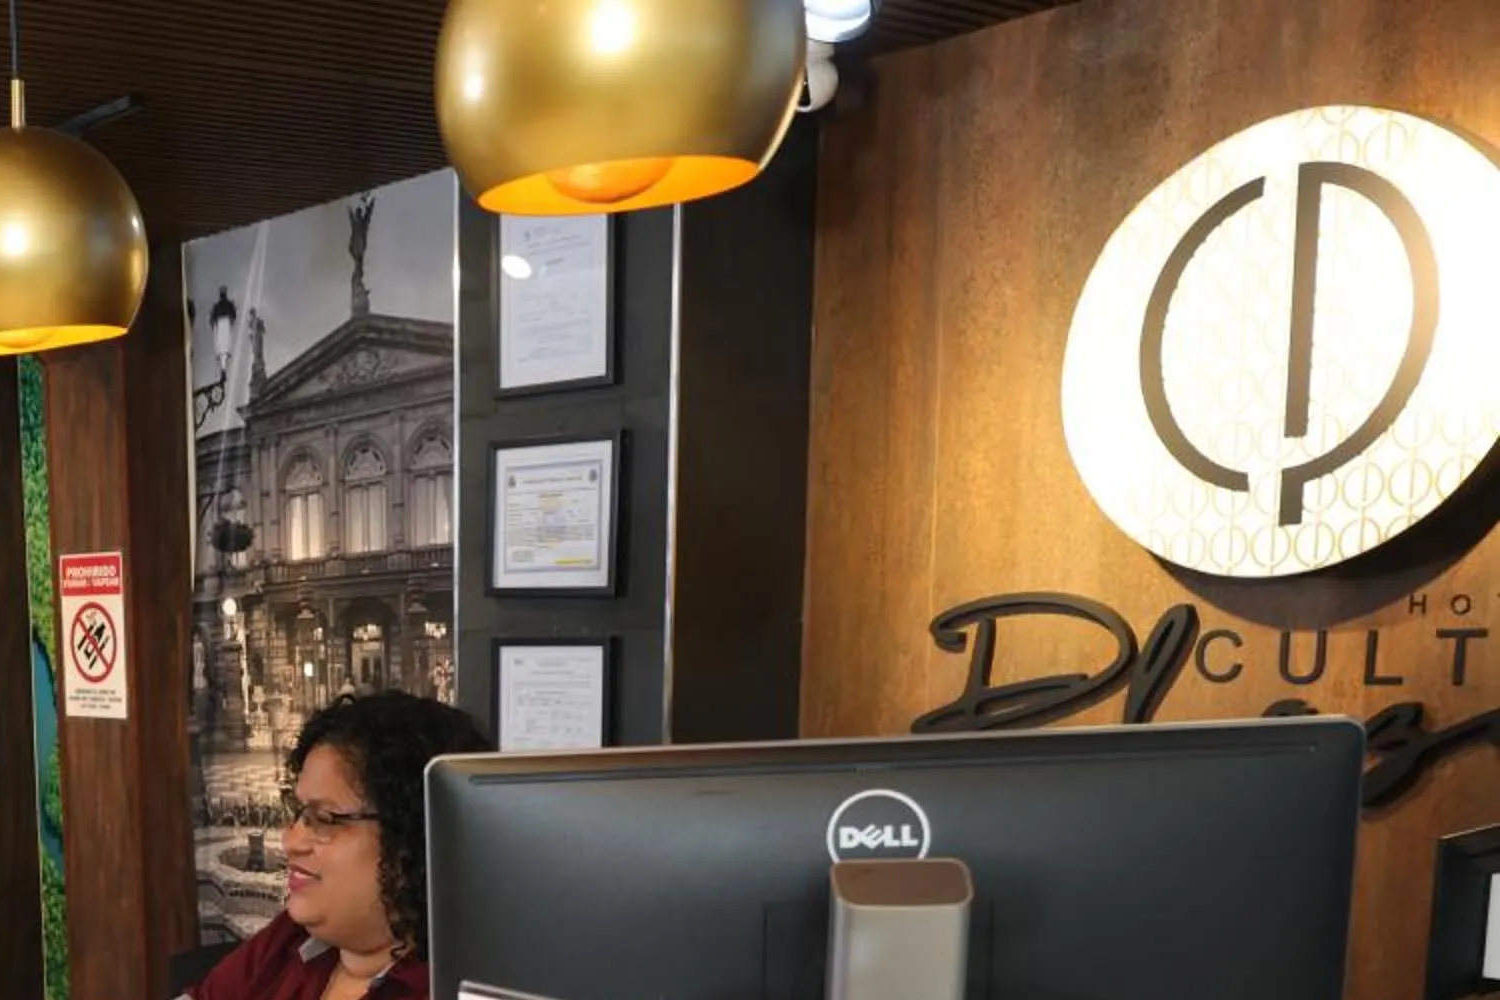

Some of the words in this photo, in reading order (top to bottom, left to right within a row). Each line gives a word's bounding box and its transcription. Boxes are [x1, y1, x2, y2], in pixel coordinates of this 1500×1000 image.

[66, 565, 116, 578] PROHIBIDO
[1409, 594, 1500, 615] HO
[839, 824, 919, 849] DELL
